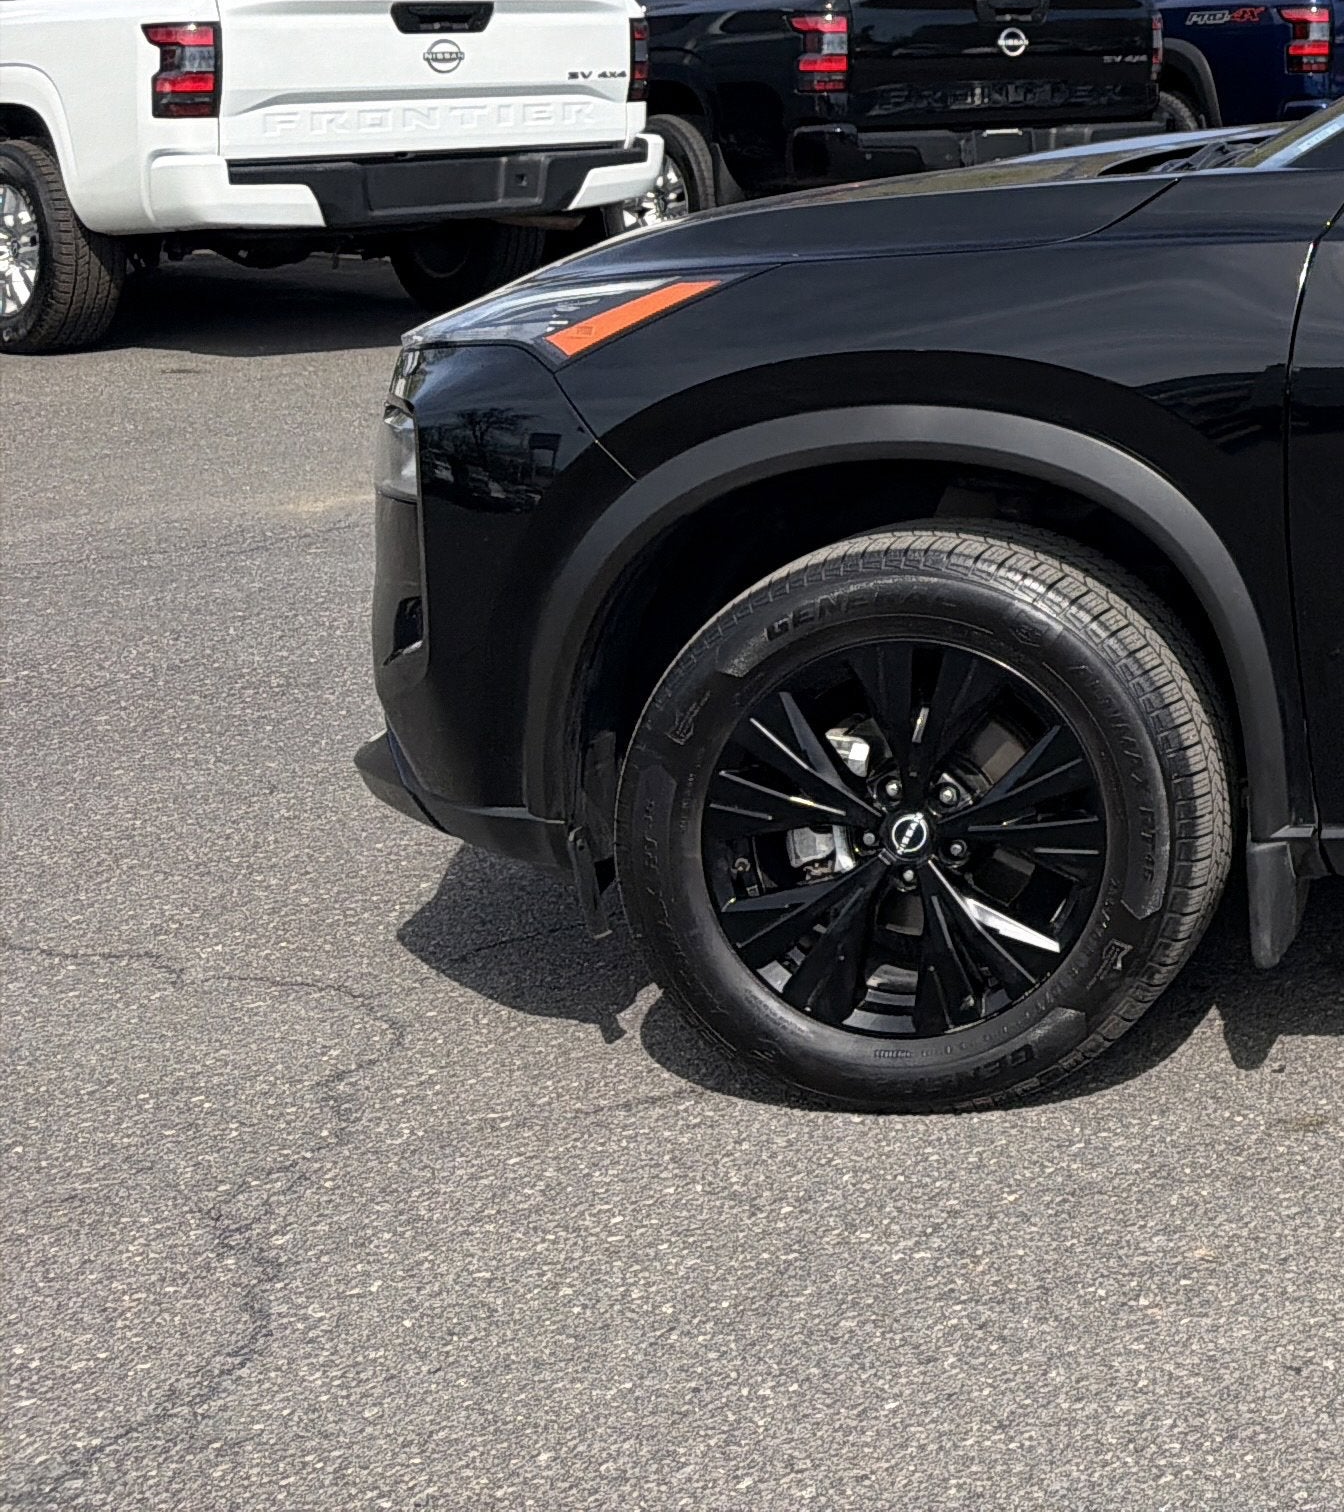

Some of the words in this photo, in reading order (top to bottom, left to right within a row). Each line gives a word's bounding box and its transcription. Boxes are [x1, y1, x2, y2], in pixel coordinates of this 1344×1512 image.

[422, 51, 466, 62] NISSAN
[567, 70, 593, 80] SV
[262, 100, 597, 138] FRONTIER
